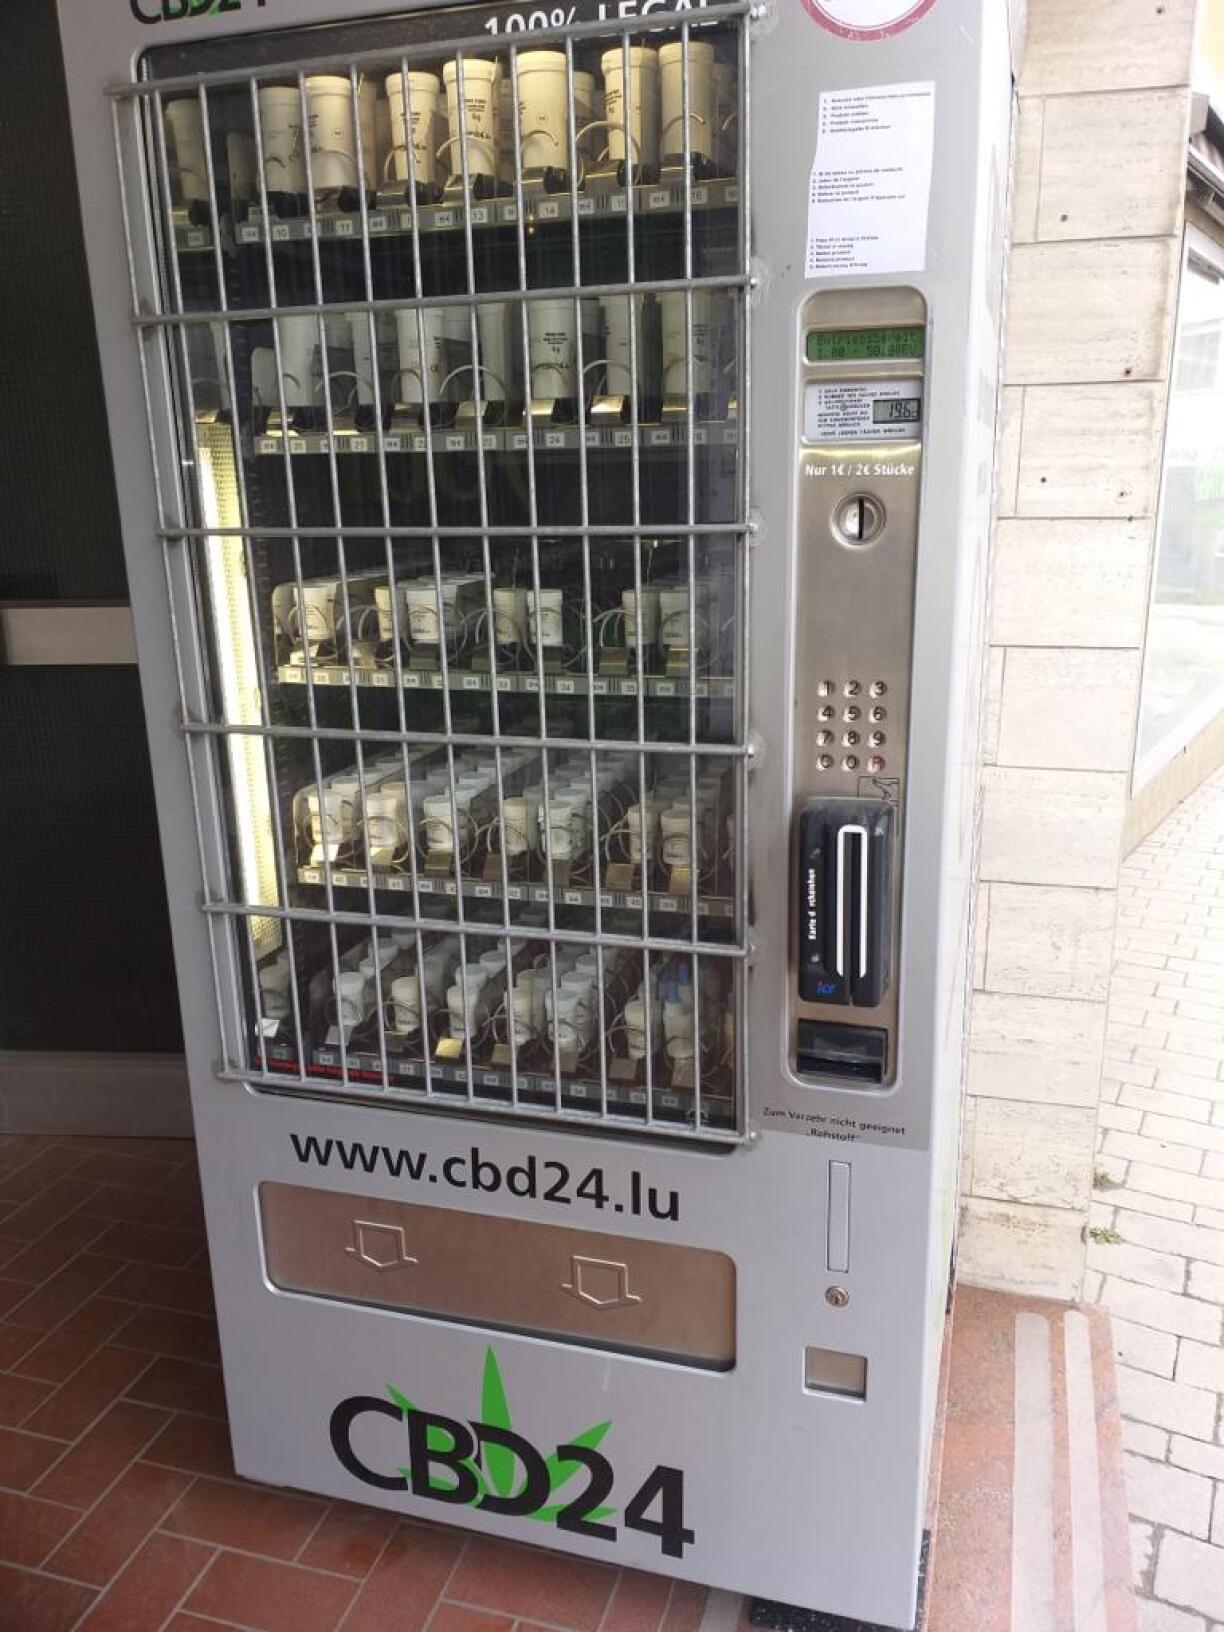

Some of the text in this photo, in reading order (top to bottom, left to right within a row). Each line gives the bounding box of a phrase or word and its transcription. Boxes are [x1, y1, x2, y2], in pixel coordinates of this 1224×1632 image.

[805, 464, 826, 476] Nur
[872, 463, 914, 476] Stücke
[763, 1106, 786, 1117] Zum
[830, 1117, 856, 1128] nicht
[289, 1133, 679, 1221] www.cbd24.lu
[329, 1395, 695, 1559] CBD24
